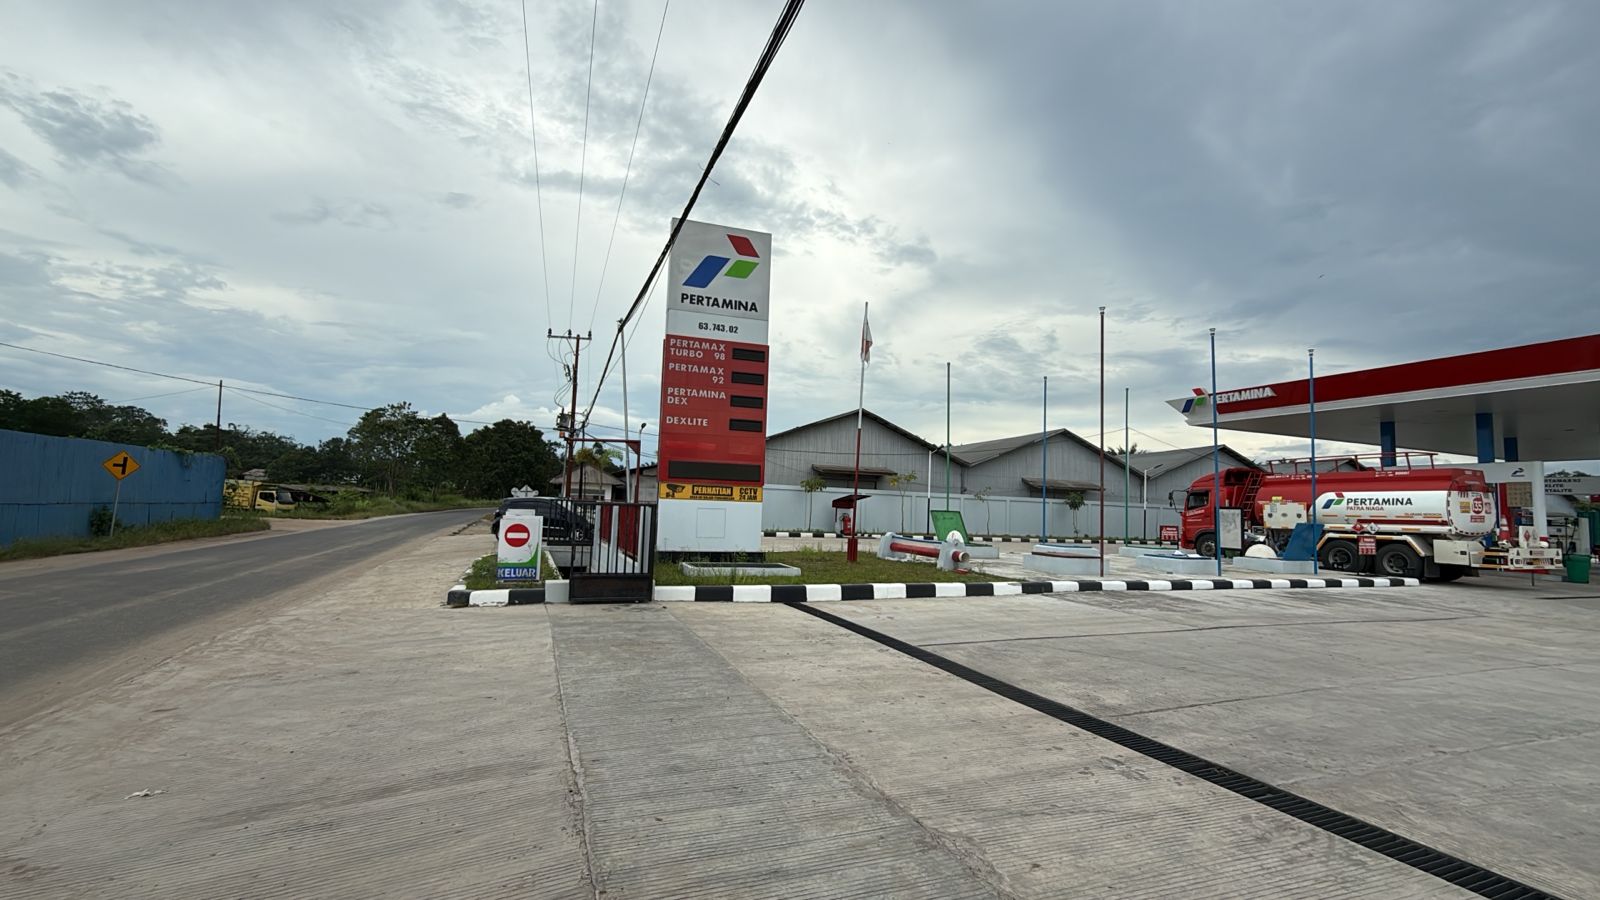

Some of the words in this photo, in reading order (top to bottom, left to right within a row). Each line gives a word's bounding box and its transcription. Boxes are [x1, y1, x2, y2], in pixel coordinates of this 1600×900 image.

[680, 293, 758, 312] PERTAMINA
[698, 322, 738, 334] 63.743.02
[670, 338, 725, 351] PERTAMAX
[670, 348, 703, 358] TURBO
[714, 352, 726, 361] 98
[668, 363, 724, 375] PERTAMAX
[712, 376, 725, 385] 92
[667, 387, 726, 399] PERTAMINA
[667, 397, 688, 405] DEX
[666, 416, 709, 427] DEXLITE
[693, 486, 732, 495] PERHATIAN
[1346, 497, 1413, 506] PERTAMINA
[497, 568, 536, 577] KELUAR
